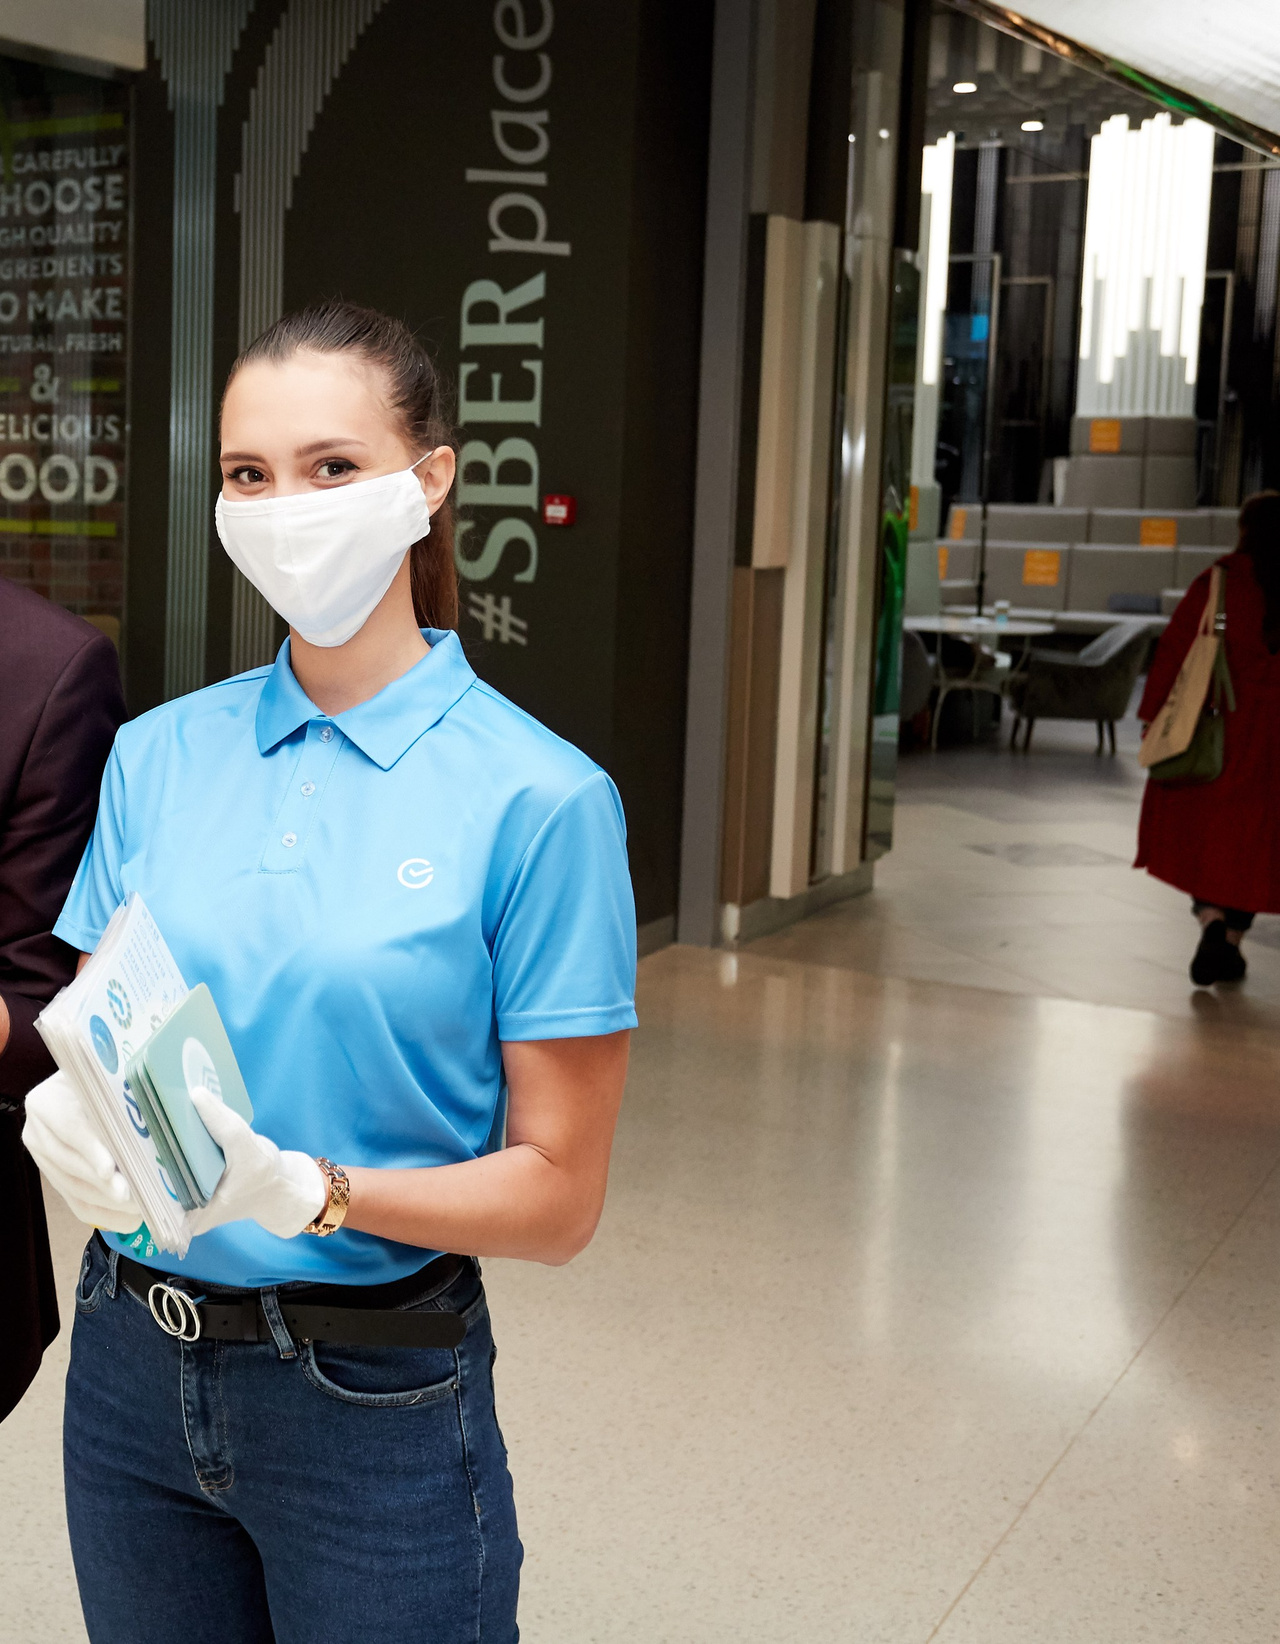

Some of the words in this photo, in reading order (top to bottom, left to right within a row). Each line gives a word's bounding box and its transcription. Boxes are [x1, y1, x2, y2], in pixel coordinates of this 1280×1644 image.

[12, 145, 124, 174] CAREFULLY
[30, 221, 123, 246] QUALITY
[27, 287, 122, 321] MAKE
[66, 332, 122, 350] FRESH
[30, 363, 60, 402] &
